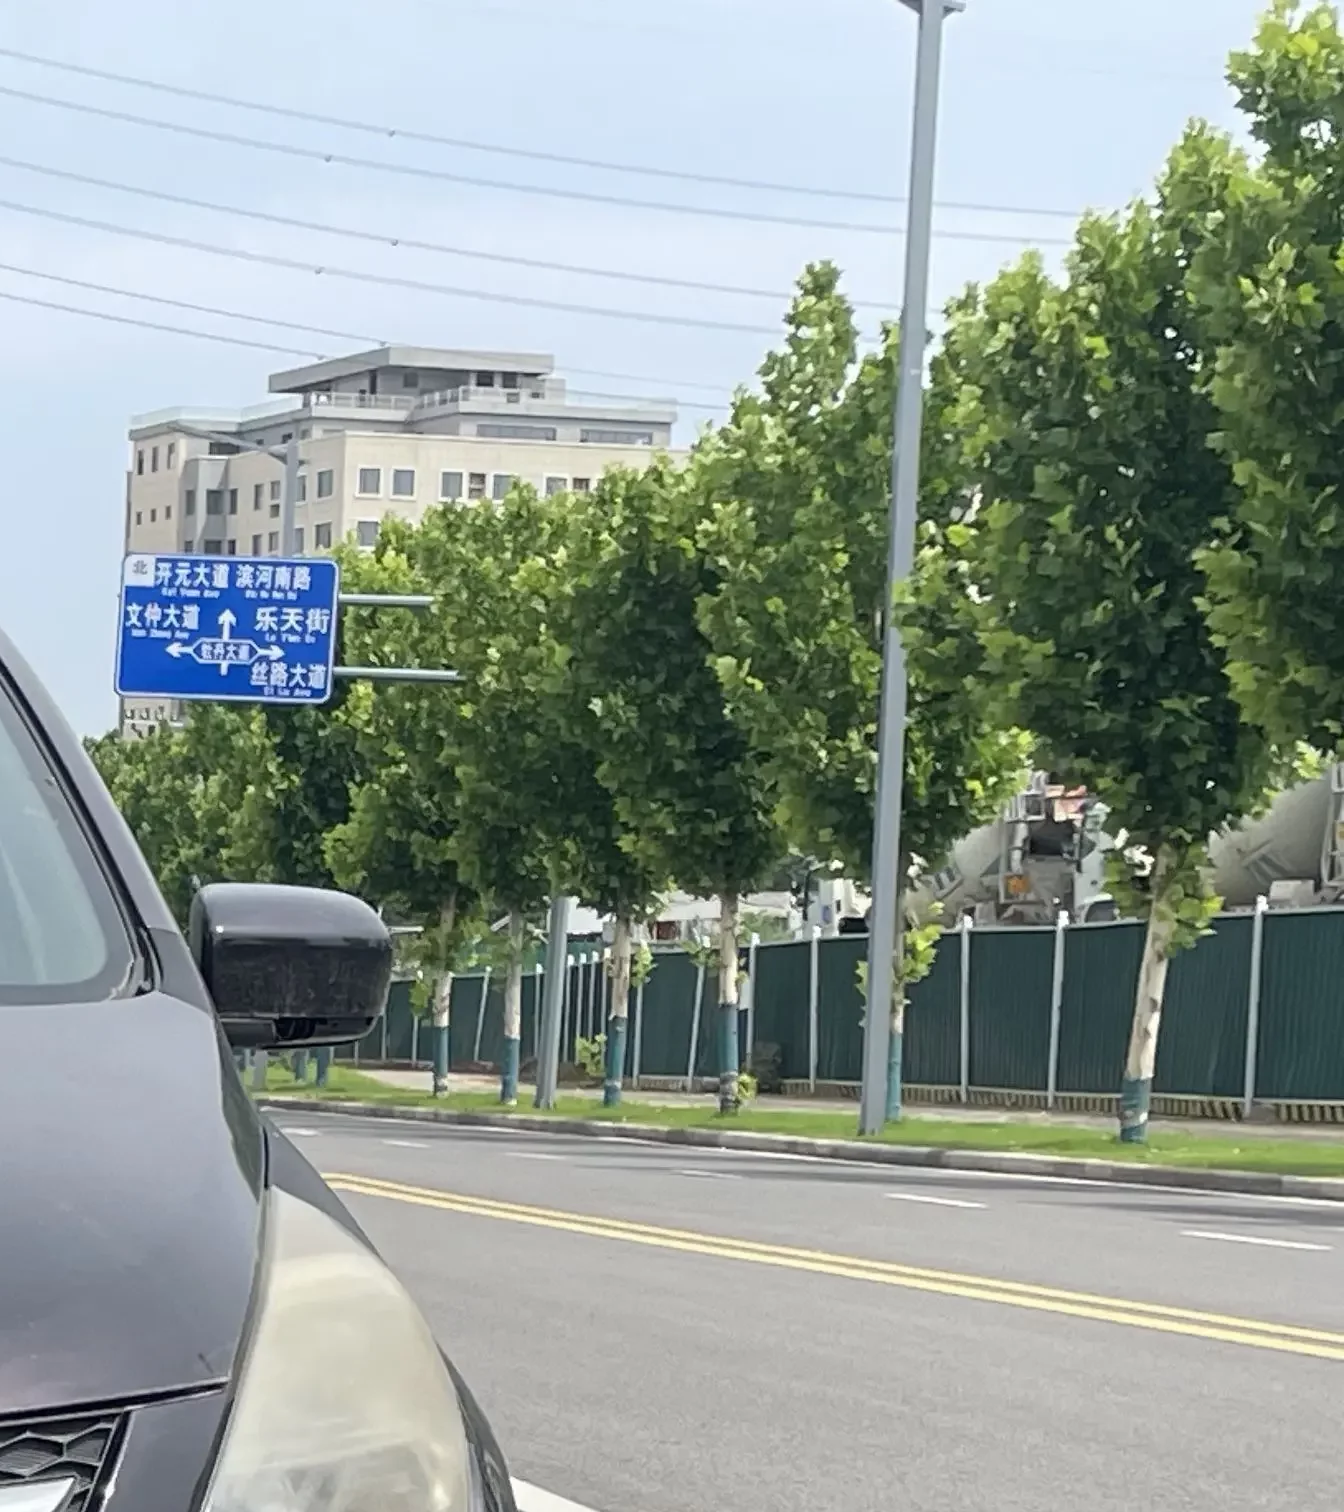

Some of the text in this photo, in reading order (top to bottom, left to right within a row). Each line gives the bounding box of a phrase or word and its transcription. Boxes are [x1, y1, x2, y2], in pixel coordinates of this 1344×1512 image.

[132, 560, 148, 575] 北
[155, 562, 311, 591] 开元大道 滨河南路
[255, 606, 330, 635] 乐天街
[250, 661, 326, 689] 丝路大道
